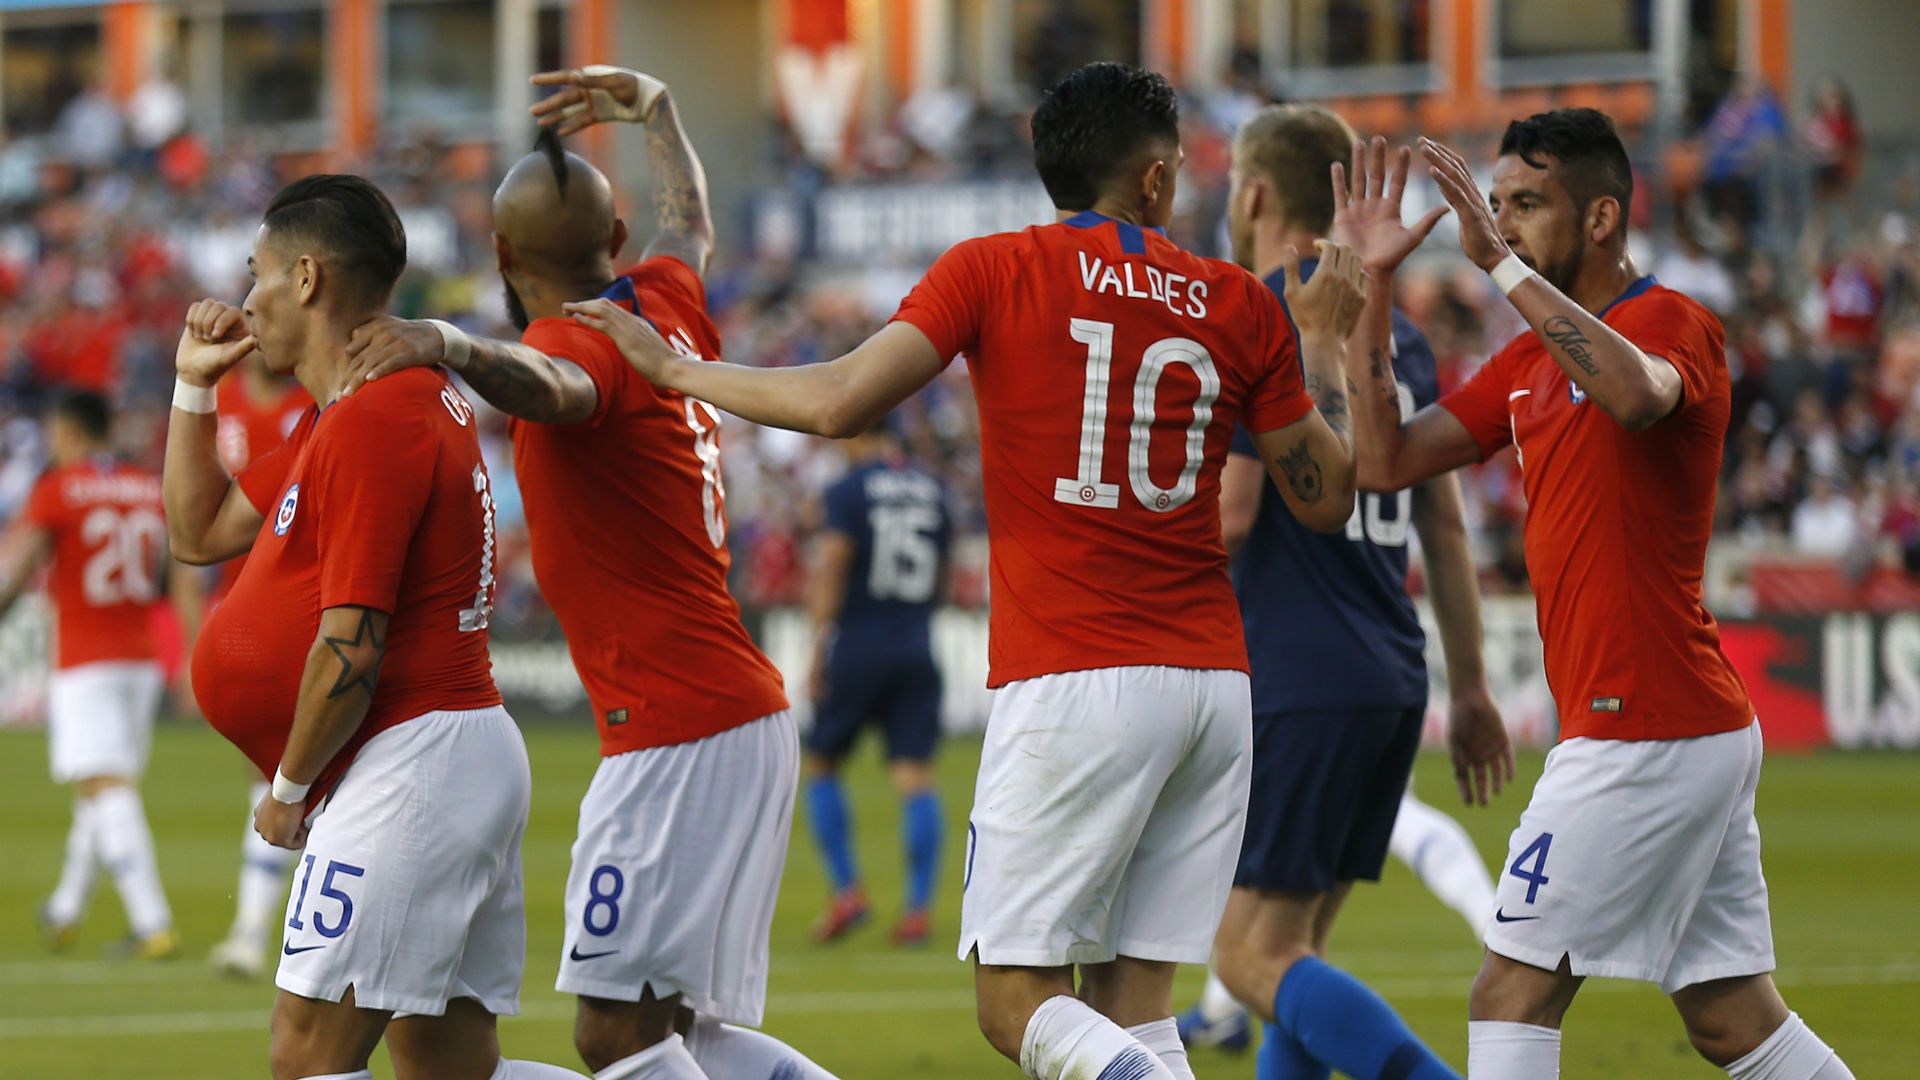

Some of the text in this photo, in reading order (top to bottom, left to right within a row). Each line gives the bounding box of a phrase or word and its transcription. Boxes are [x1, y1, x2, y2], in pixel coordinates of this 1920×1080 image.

[1077, 250, 1208, 319] VALDES
[1053, 317, 1221, 513] 10
[82, 506, 169, 608] 20
[867, 505, 943, 603] 15
[288, 853, 365, 939] 15
[583, 865, 624, 937] 8
[1509, 831, 1553, 905] 4
